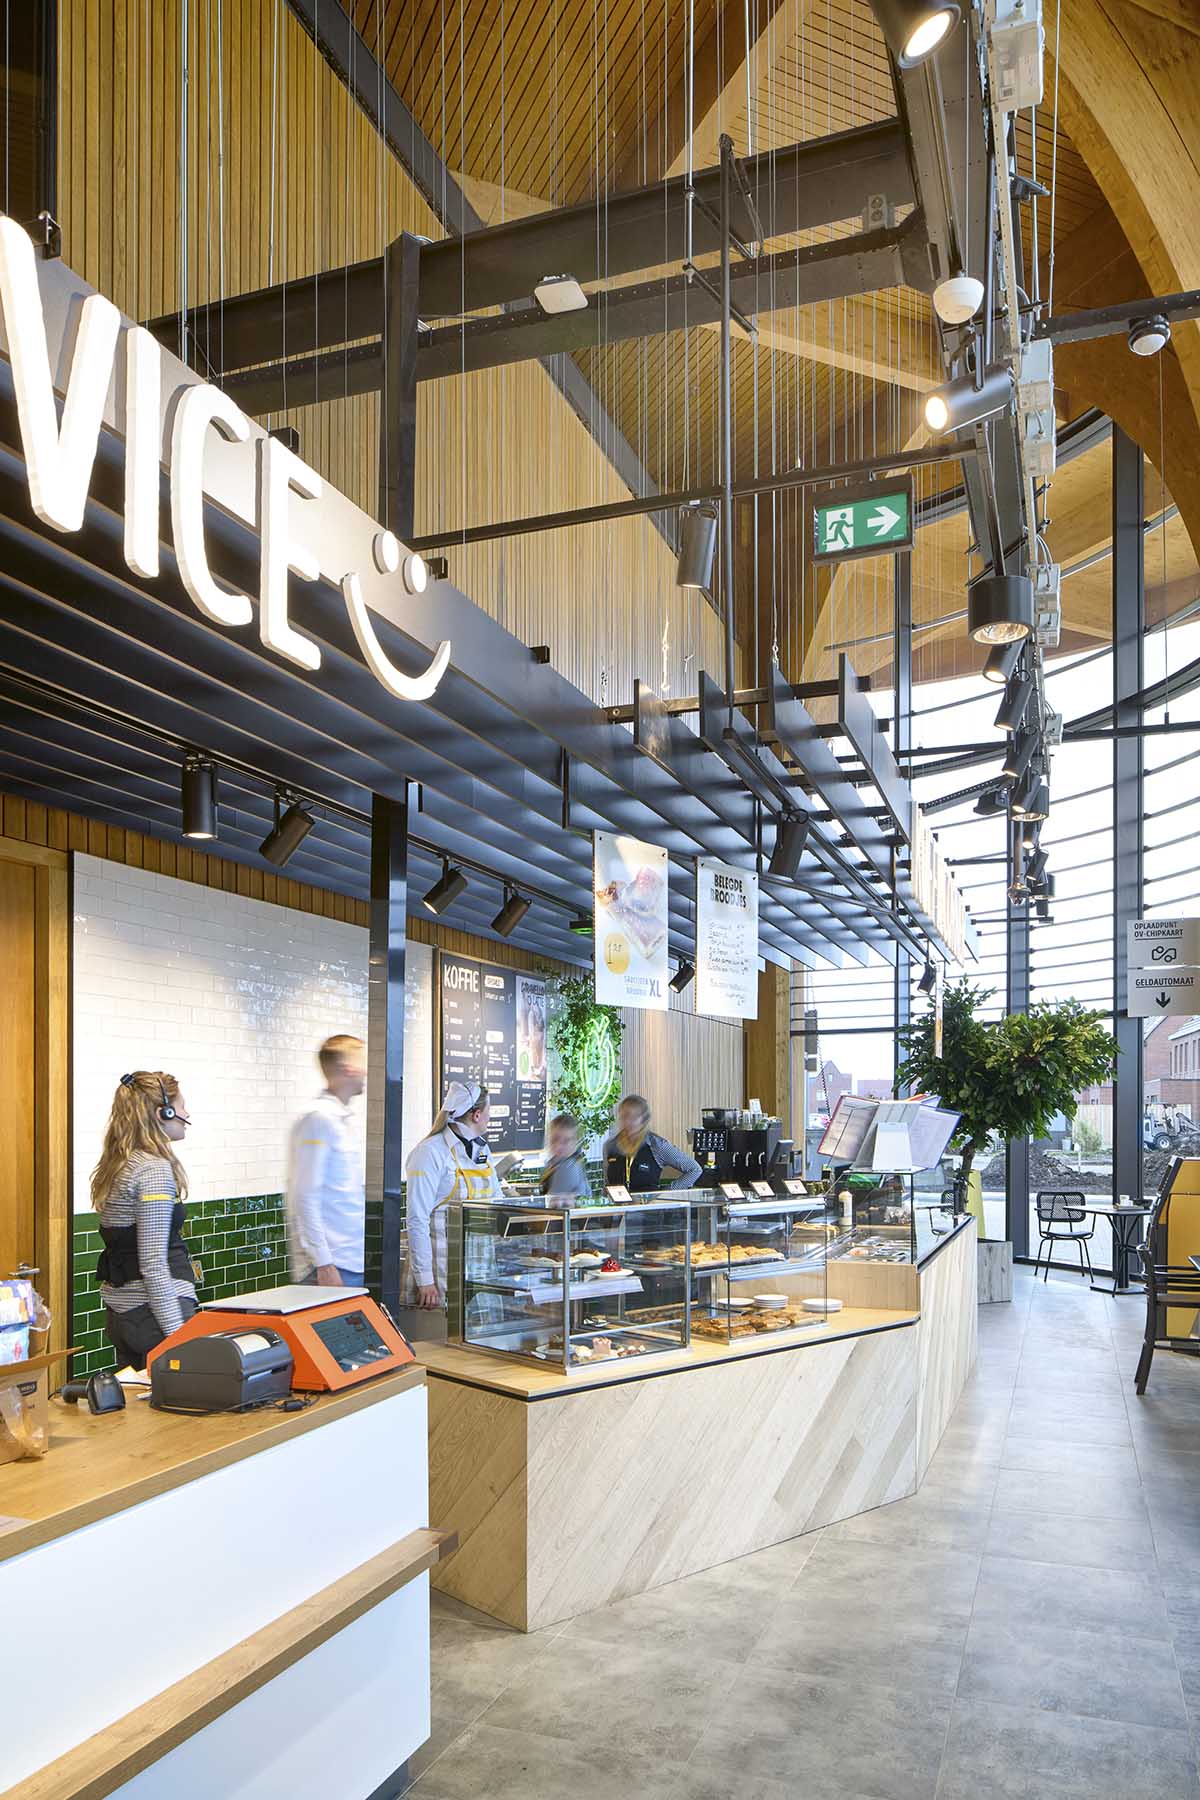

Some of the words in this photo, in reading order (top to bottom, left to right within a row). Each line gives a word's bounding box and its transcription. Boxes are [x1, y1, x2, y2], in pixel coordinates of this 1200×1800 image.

[0, 216, 323, 671] VICE
[714, 874, 743, 893] BELEGDE
[710, 888, 747, 908] BROODJES
[1134, 921, 1177, 929] OPLAADPUNT
[1134, 929, 1183, 937] OV-CHIPKAART
[444, 964, 480, 993] KOFFIE
[649, 978, 662, 998] XL
[1135, 977, 1194, 986] GELDAUTOMAAT
